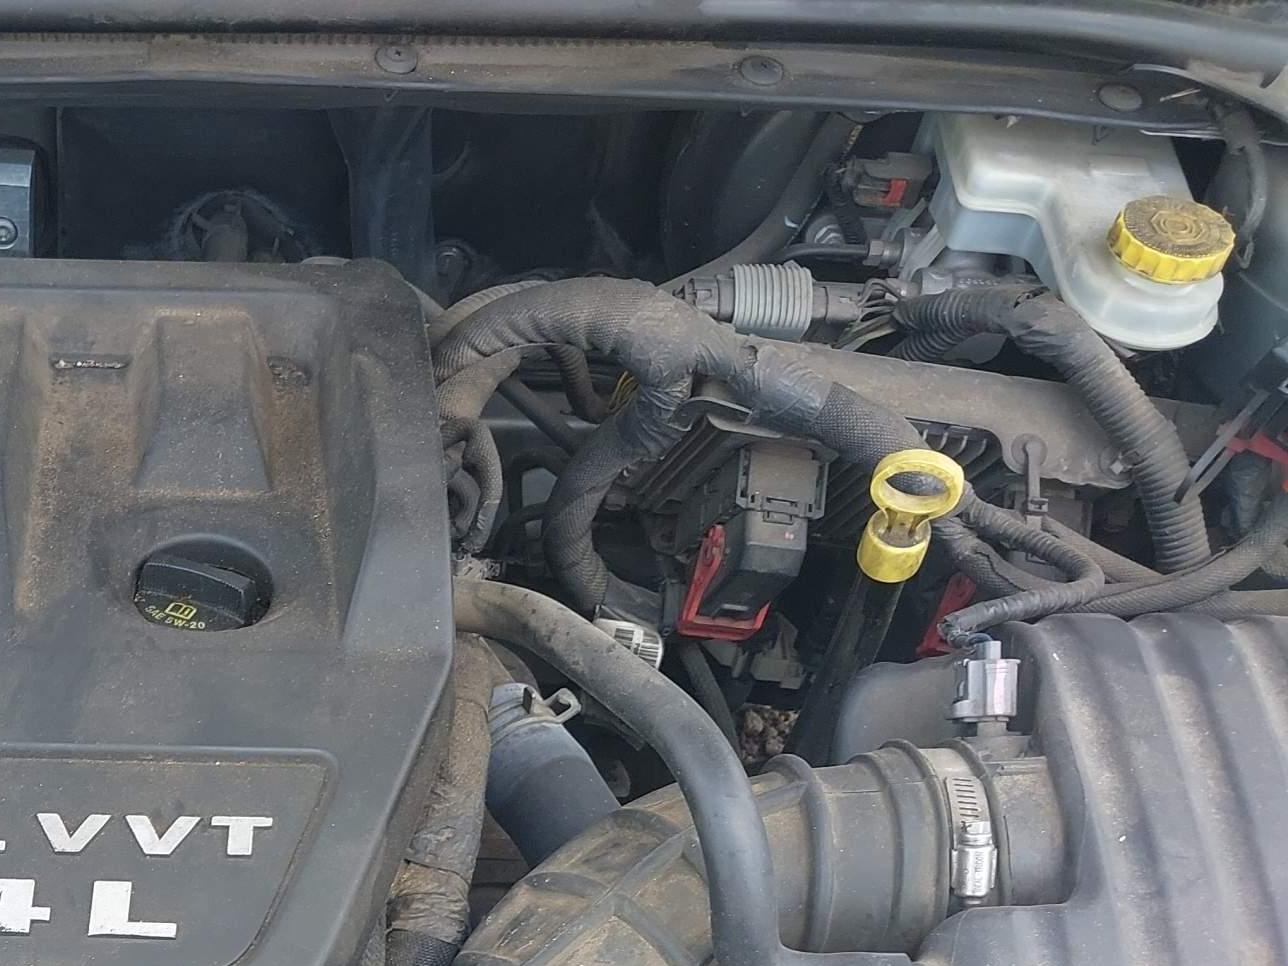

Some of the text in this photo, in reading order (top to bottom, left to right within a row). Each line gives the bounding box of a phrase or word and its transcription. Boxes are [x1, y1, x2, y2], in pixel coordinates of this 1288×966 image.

[144, 605, 206, 630] SAE 5W-20
[36, 812, 274, 856] VVT
[88, 880, 178, 938] L
